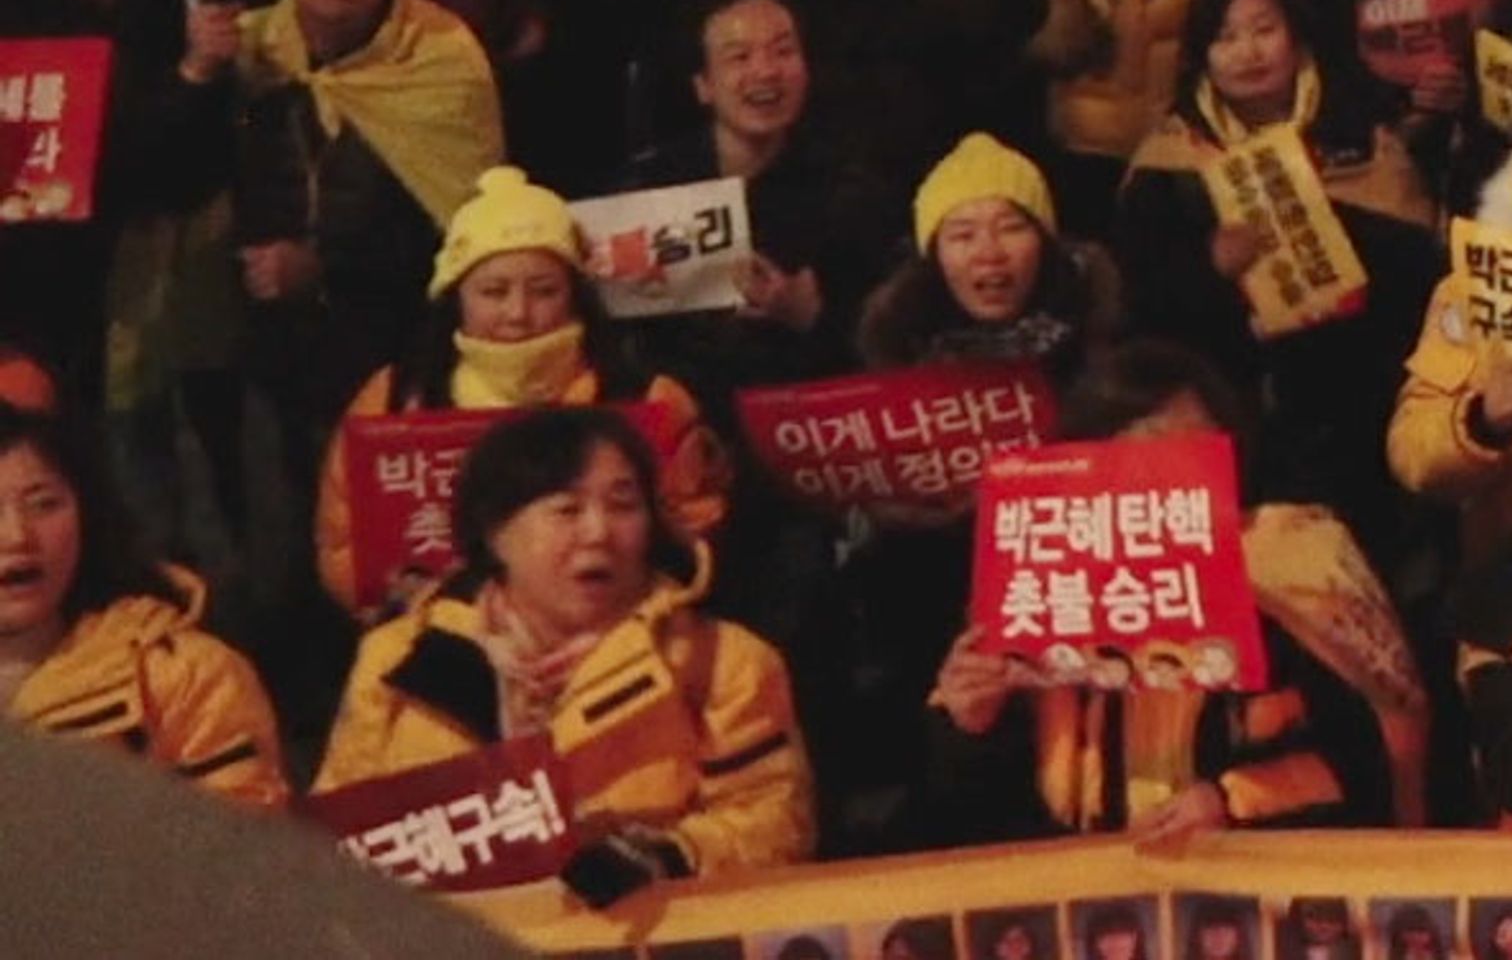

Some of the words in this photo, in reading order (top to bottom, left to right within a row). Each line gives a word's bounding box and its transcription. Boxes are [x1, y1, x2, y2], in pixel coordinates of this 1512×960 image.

[775, 409, 878, 458] 이게
[880, 381, 1036, 445] 나라다
[794, 456, 894, 499] 이게
[995, 492, 1115, 564] 박근혜
[1117, 486, 1214, 559] 탄핵
[1001, 569, 1095, 638] 촛불
[1101, 561, 1205, 633] 승리
[346, 769, 566, 883] 근혜구속!
